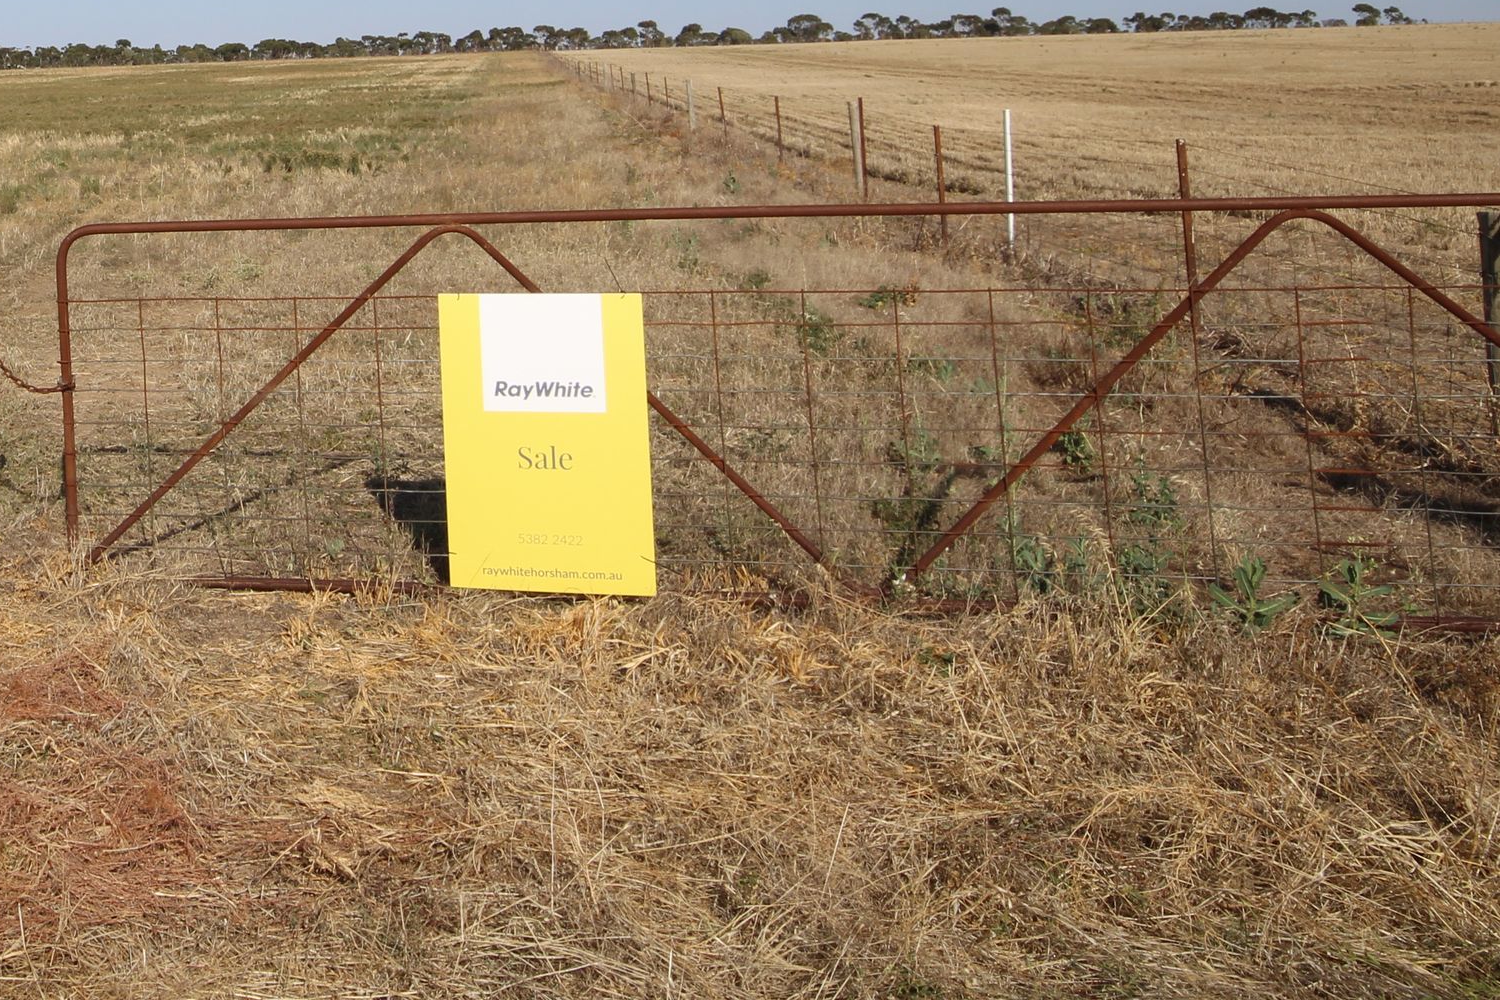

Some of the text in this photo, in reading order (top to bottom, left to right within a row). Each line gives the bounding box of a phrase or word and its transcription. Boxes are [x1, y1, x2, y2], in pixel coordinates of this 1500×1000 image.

[517, 446, 573, 470] Sale
[517, 533, 583, 547] 5382 2422
[482, 566, 623, 581] raywhitehorsham.com.au
